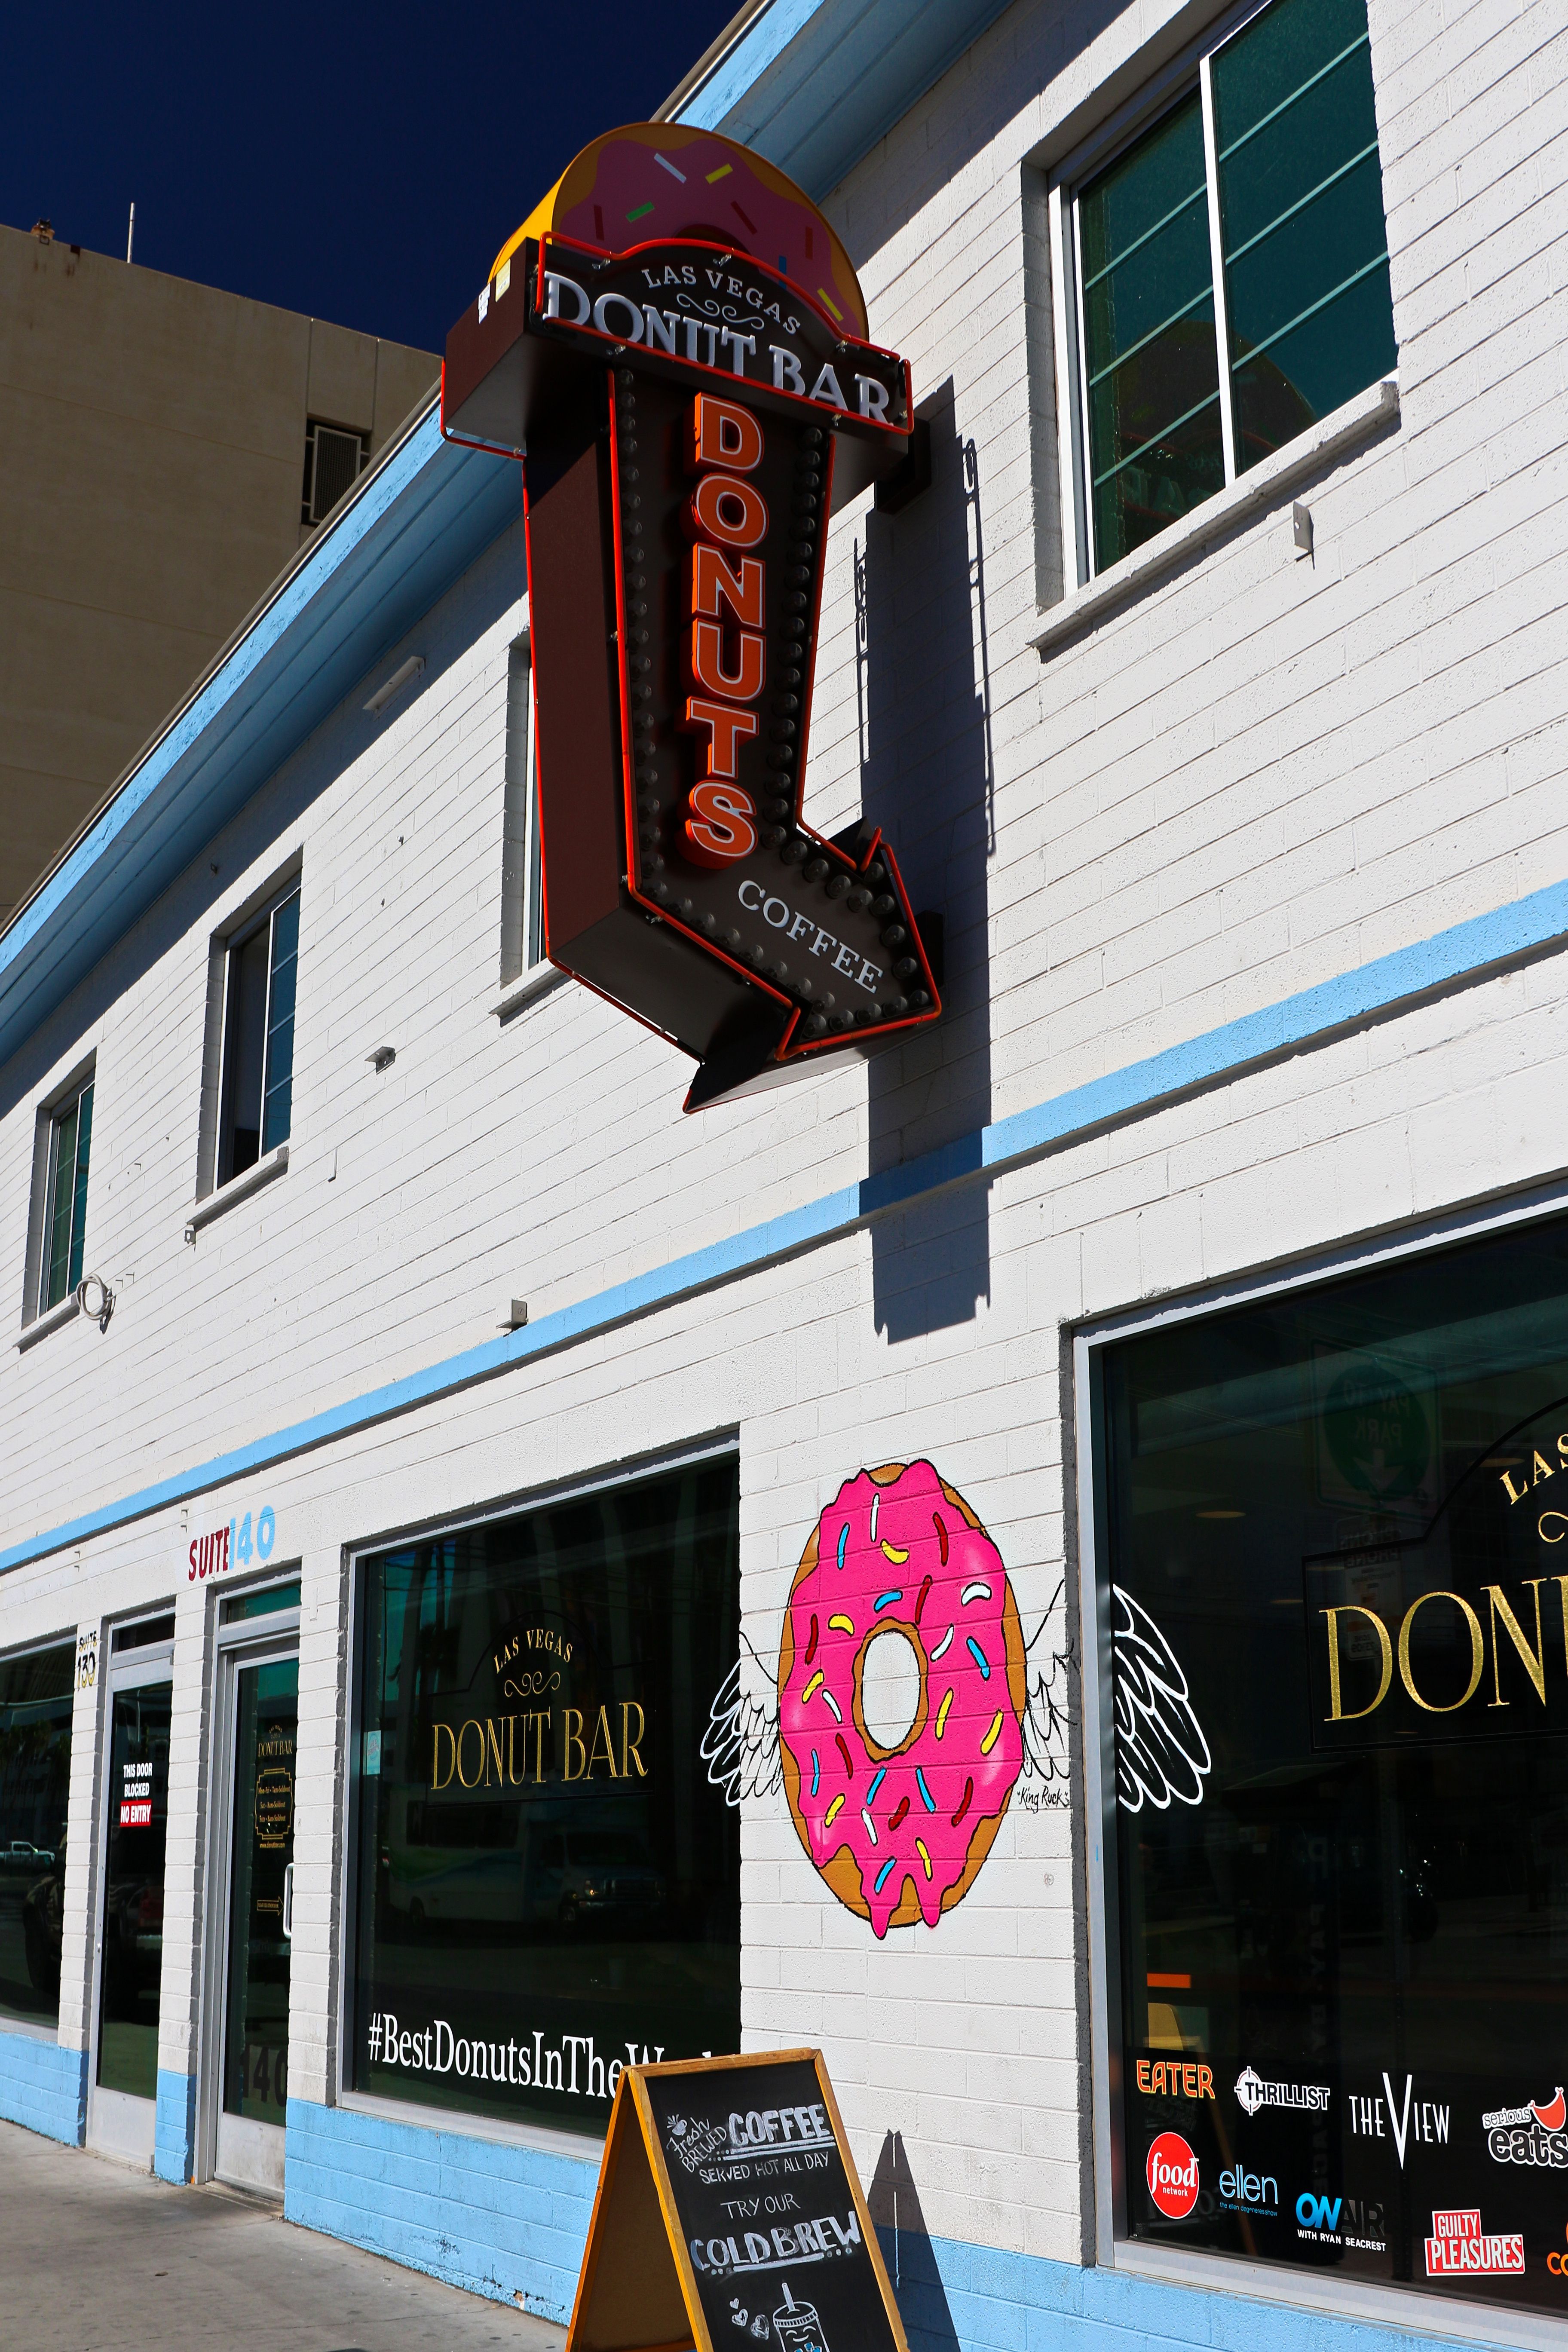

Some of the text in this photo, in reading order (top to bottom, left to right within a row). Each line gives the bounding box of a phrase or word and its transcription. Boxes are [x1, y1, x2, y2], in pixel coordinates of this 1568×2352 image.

[640, 265, 801, 335] LAS VEGAS
[542, 271, 756, 378] DONUT
[769, 344, 893, 426] BAR
[682, 392, 768, 862] DONUTS
[737, 879, 884, 996] COFFEE
[1499, 1434, 1568, 1505] LAS
[79, 1630, 97, 1652] SUITE
[494, 1629, 573, 1674] LAS VEGAS
[77, 1651, 95, 1690] 130
[258, 1739, 292, 1757] DONUT BAR
[431, 1701, 648, 1790] DONUT BAR
[123, 1762, 153, 1778] THIS DOOR
[124, 1782, 150, 1798] BLOCKED
[120, 1804, 151, 1824] NO ENTRY
[239, 2043, 288, 2107] 140
[1136, 2059, 1216, 2099] EATER
[1244, 2081, 1330, 2110] THRILLIST
[666, 2116, 710, 2159] Fresh
[729, 2104, 830, 2147] COFFEE
[1348, 2072, 1450, 2171] THE VIEW
[1483, 2107, 1531, 2128] serious
[681, 2126, 727, 2173] BREWED
[1488, 2123, 1568, 2168] eats
[699, 2151, 829, 2184] SERVED HOT ALL DAY
[1151, 2152, 1197, 2194] food
[1219, 2164, 1278, 2205] ellen
[720, 2193, 801, 2219] TRY OUR
[1162, 2186, 1189, 2197] network
[690, 2211, 861, 2271] COLD BREW
[1297, 2229, 1386, 2252] WITH RYAN SEACREST
[1437, 2214, 1478, 2239] GUILTY
[1430, 2237, 1524, 2271] PLEASURES
